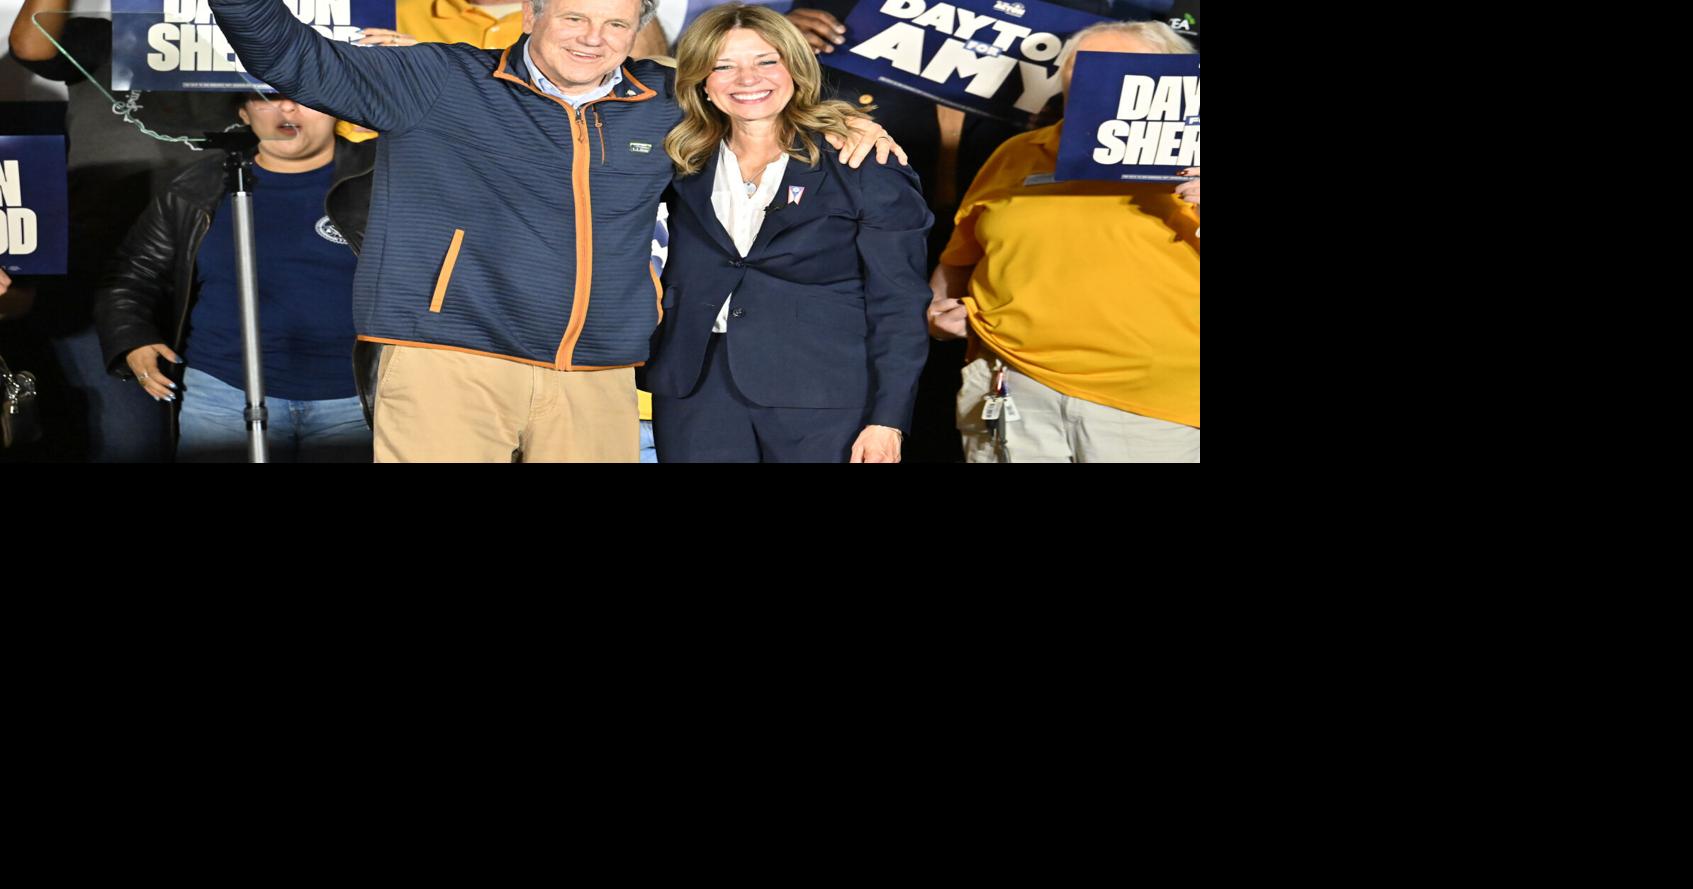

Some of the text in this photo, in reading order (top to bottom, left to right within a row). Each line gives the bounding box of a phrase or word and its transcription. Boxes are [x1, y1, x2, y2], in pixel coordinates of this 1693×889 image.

[1168, 17, 1190, 31] EA
[965, 40, 1000, 57] FOR
[849, 21, 1064, 115] AMY
[1092, 119, 1200, 166] SHER
